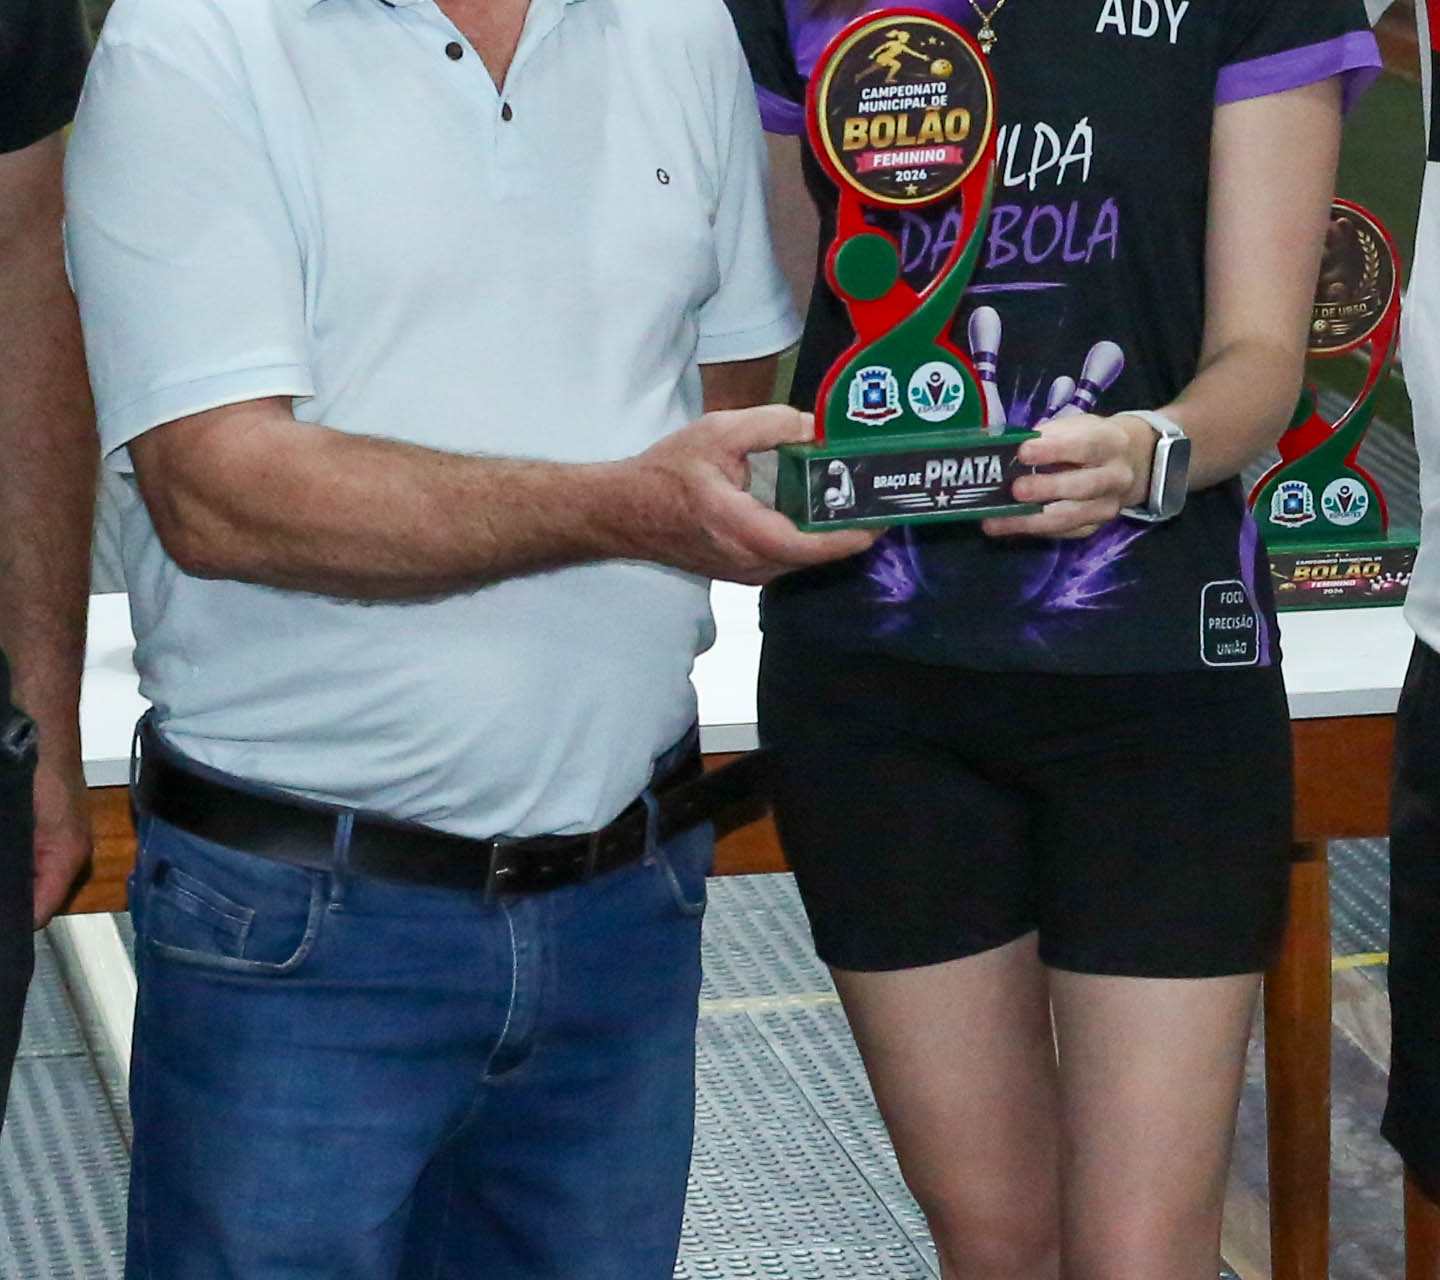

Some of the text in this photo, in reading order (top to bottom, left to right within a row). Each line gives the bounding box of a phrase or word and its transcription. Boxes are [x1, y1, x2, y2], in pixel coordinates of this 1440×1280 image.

[861, 81, 947, 101] CAMPEONATO
[858, 95, 948, 114] MUNICIPAL DE
[842, 106, 971, 152] BOLÃO
[873, 148, 947, 168] FEMININO
[895, 168, 928, 183] 2026
[986, 197, 1119, 270] BOLA
[873, 454, 1004, 490] BRAÇO DE PRATA
[1208, 614, 1254, 630] PRECISÃO
